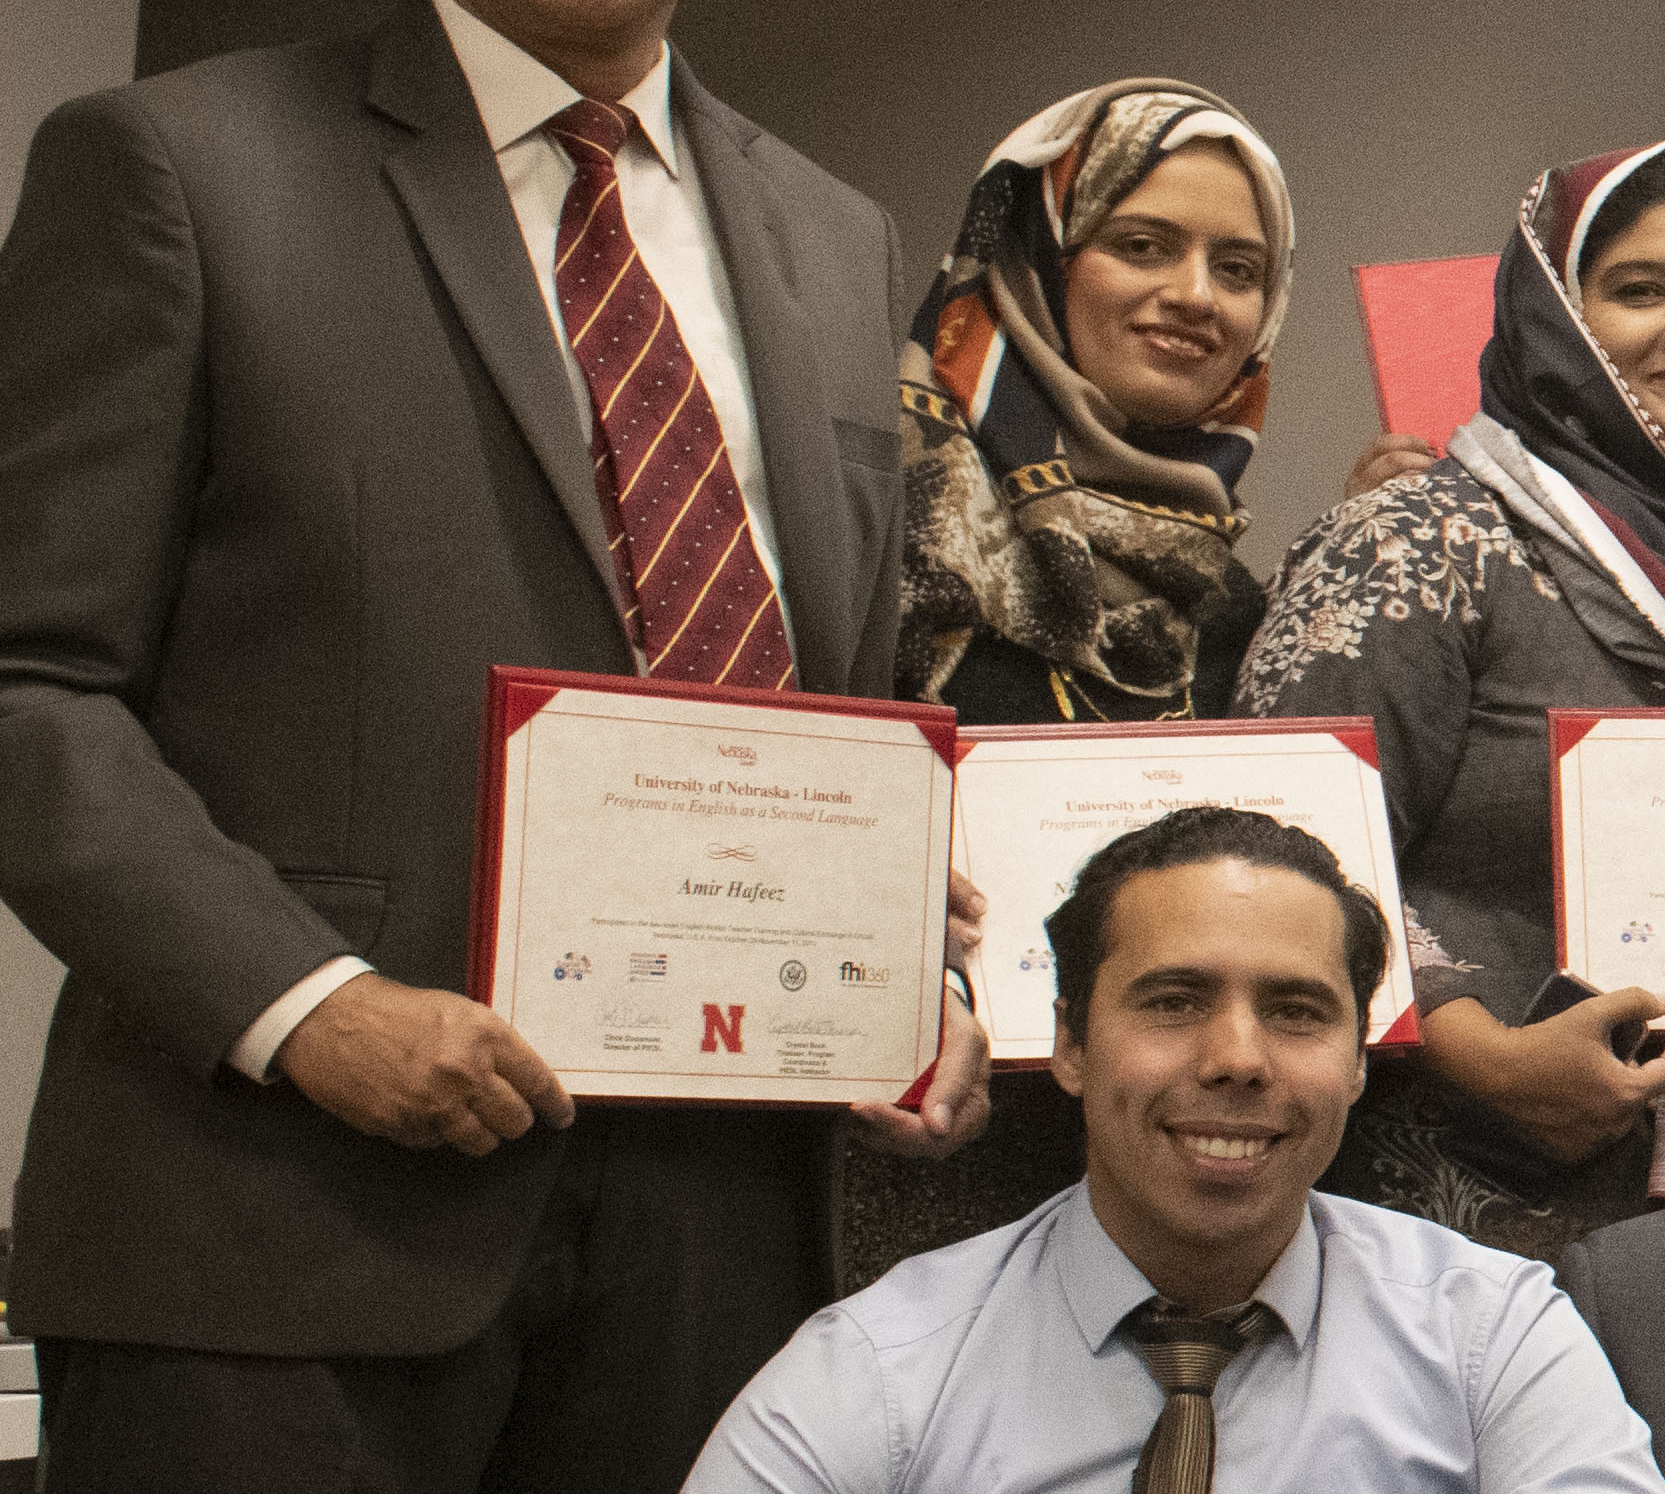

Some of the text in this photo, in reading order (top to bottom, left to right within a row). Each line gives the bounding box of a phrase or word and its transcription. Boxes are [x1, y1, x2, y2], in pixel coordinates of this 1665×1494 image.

[634, 774, 852, 804] University of Nebraska Lincoln
[1066, 800, 1136, 813] University
[1140, 799, 1153, 811] of
[1234, 795, 1284, 807] Lincoln
[678, 879, 786, 902] Amir Hafeez
[701, 1003, 747, 1053] N
